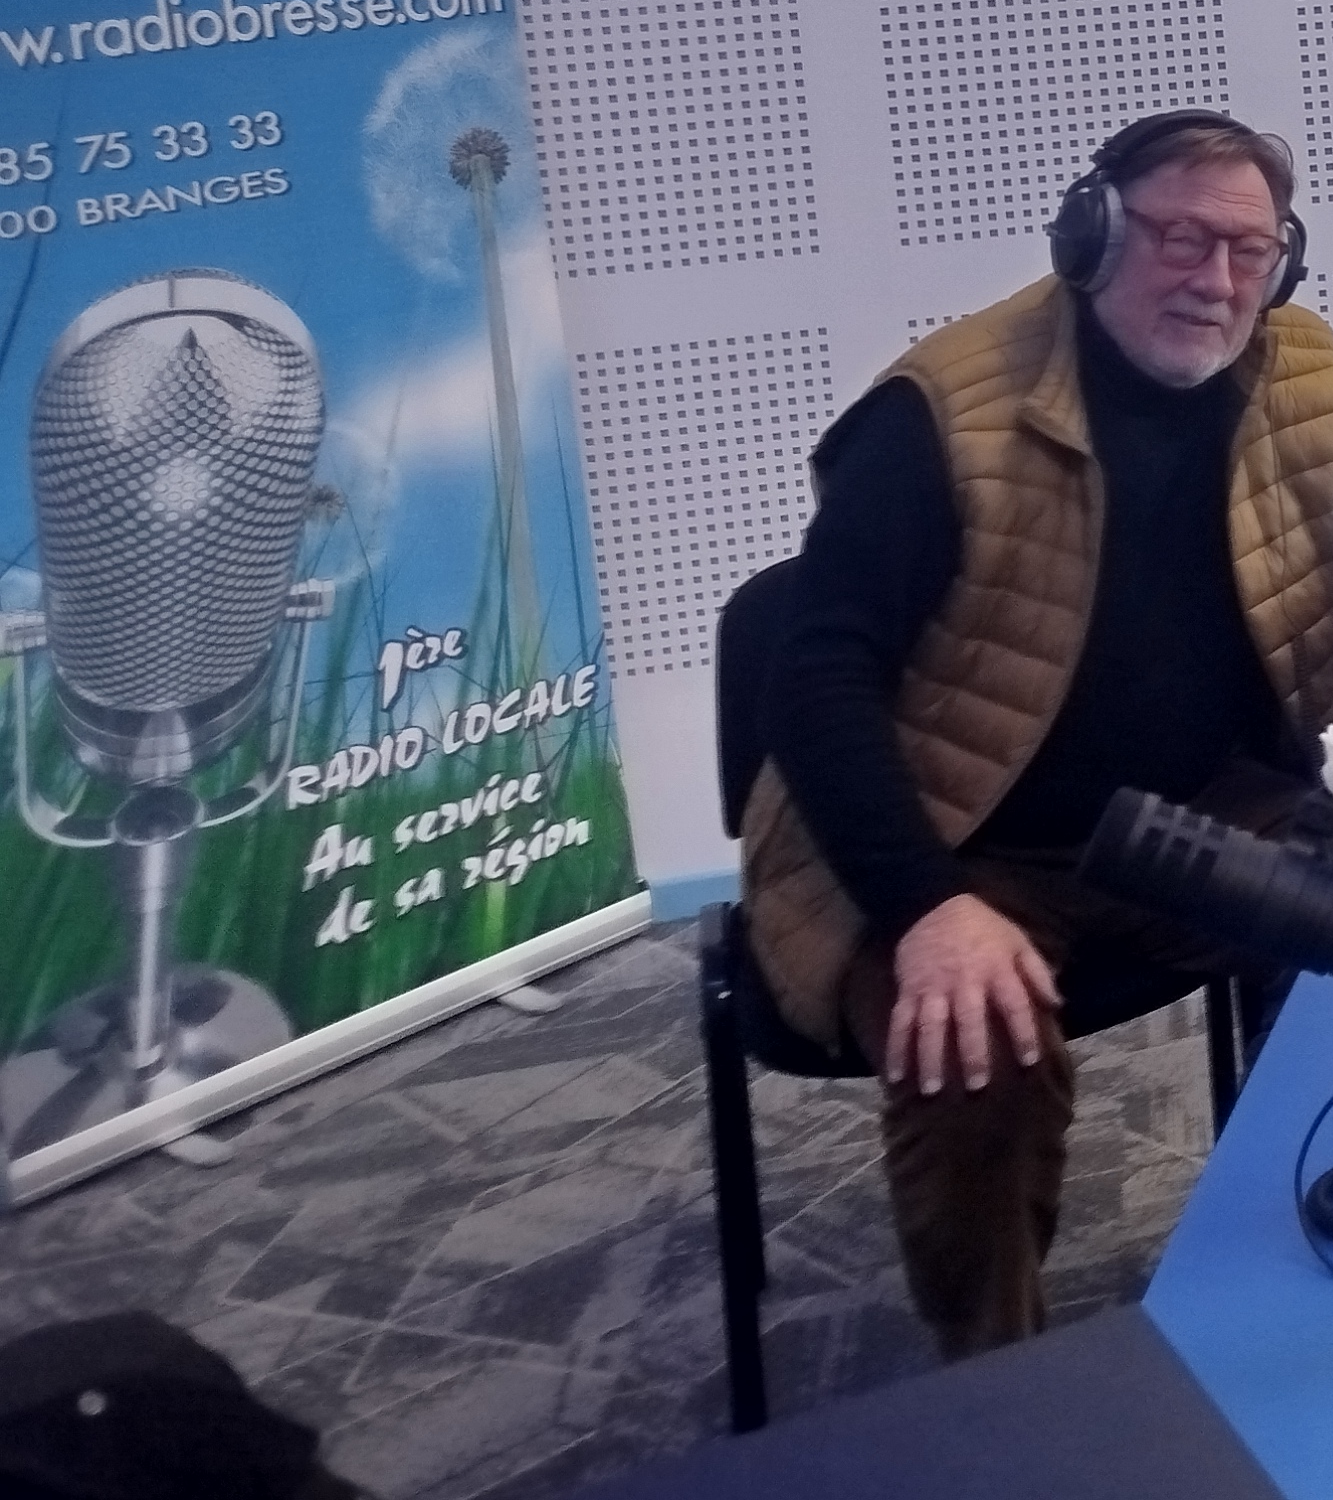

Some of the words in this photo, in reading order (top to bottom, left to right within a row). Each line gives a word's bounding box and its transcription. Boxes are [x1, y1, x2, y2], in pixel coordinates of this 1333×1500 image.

[0, 142, 51, 186] 85
[74, 131, 132, 174] 75
[153, 120, 209, 162] 33
[228, 110, 283, 148] 33
[77, 167, 290, 226] BRANGES
[379, 626, 468, 710] 1ère
[285, 726, 425, 810] RADIO
[441, 663, 598, 755] LOCALE
[302, 823, 376, 892] Au
[391, 772, 544, 853] service
[314, 884, 377, 948] de
[393, 867, 446, 918] sa
[461, 815, 592, 890] région
